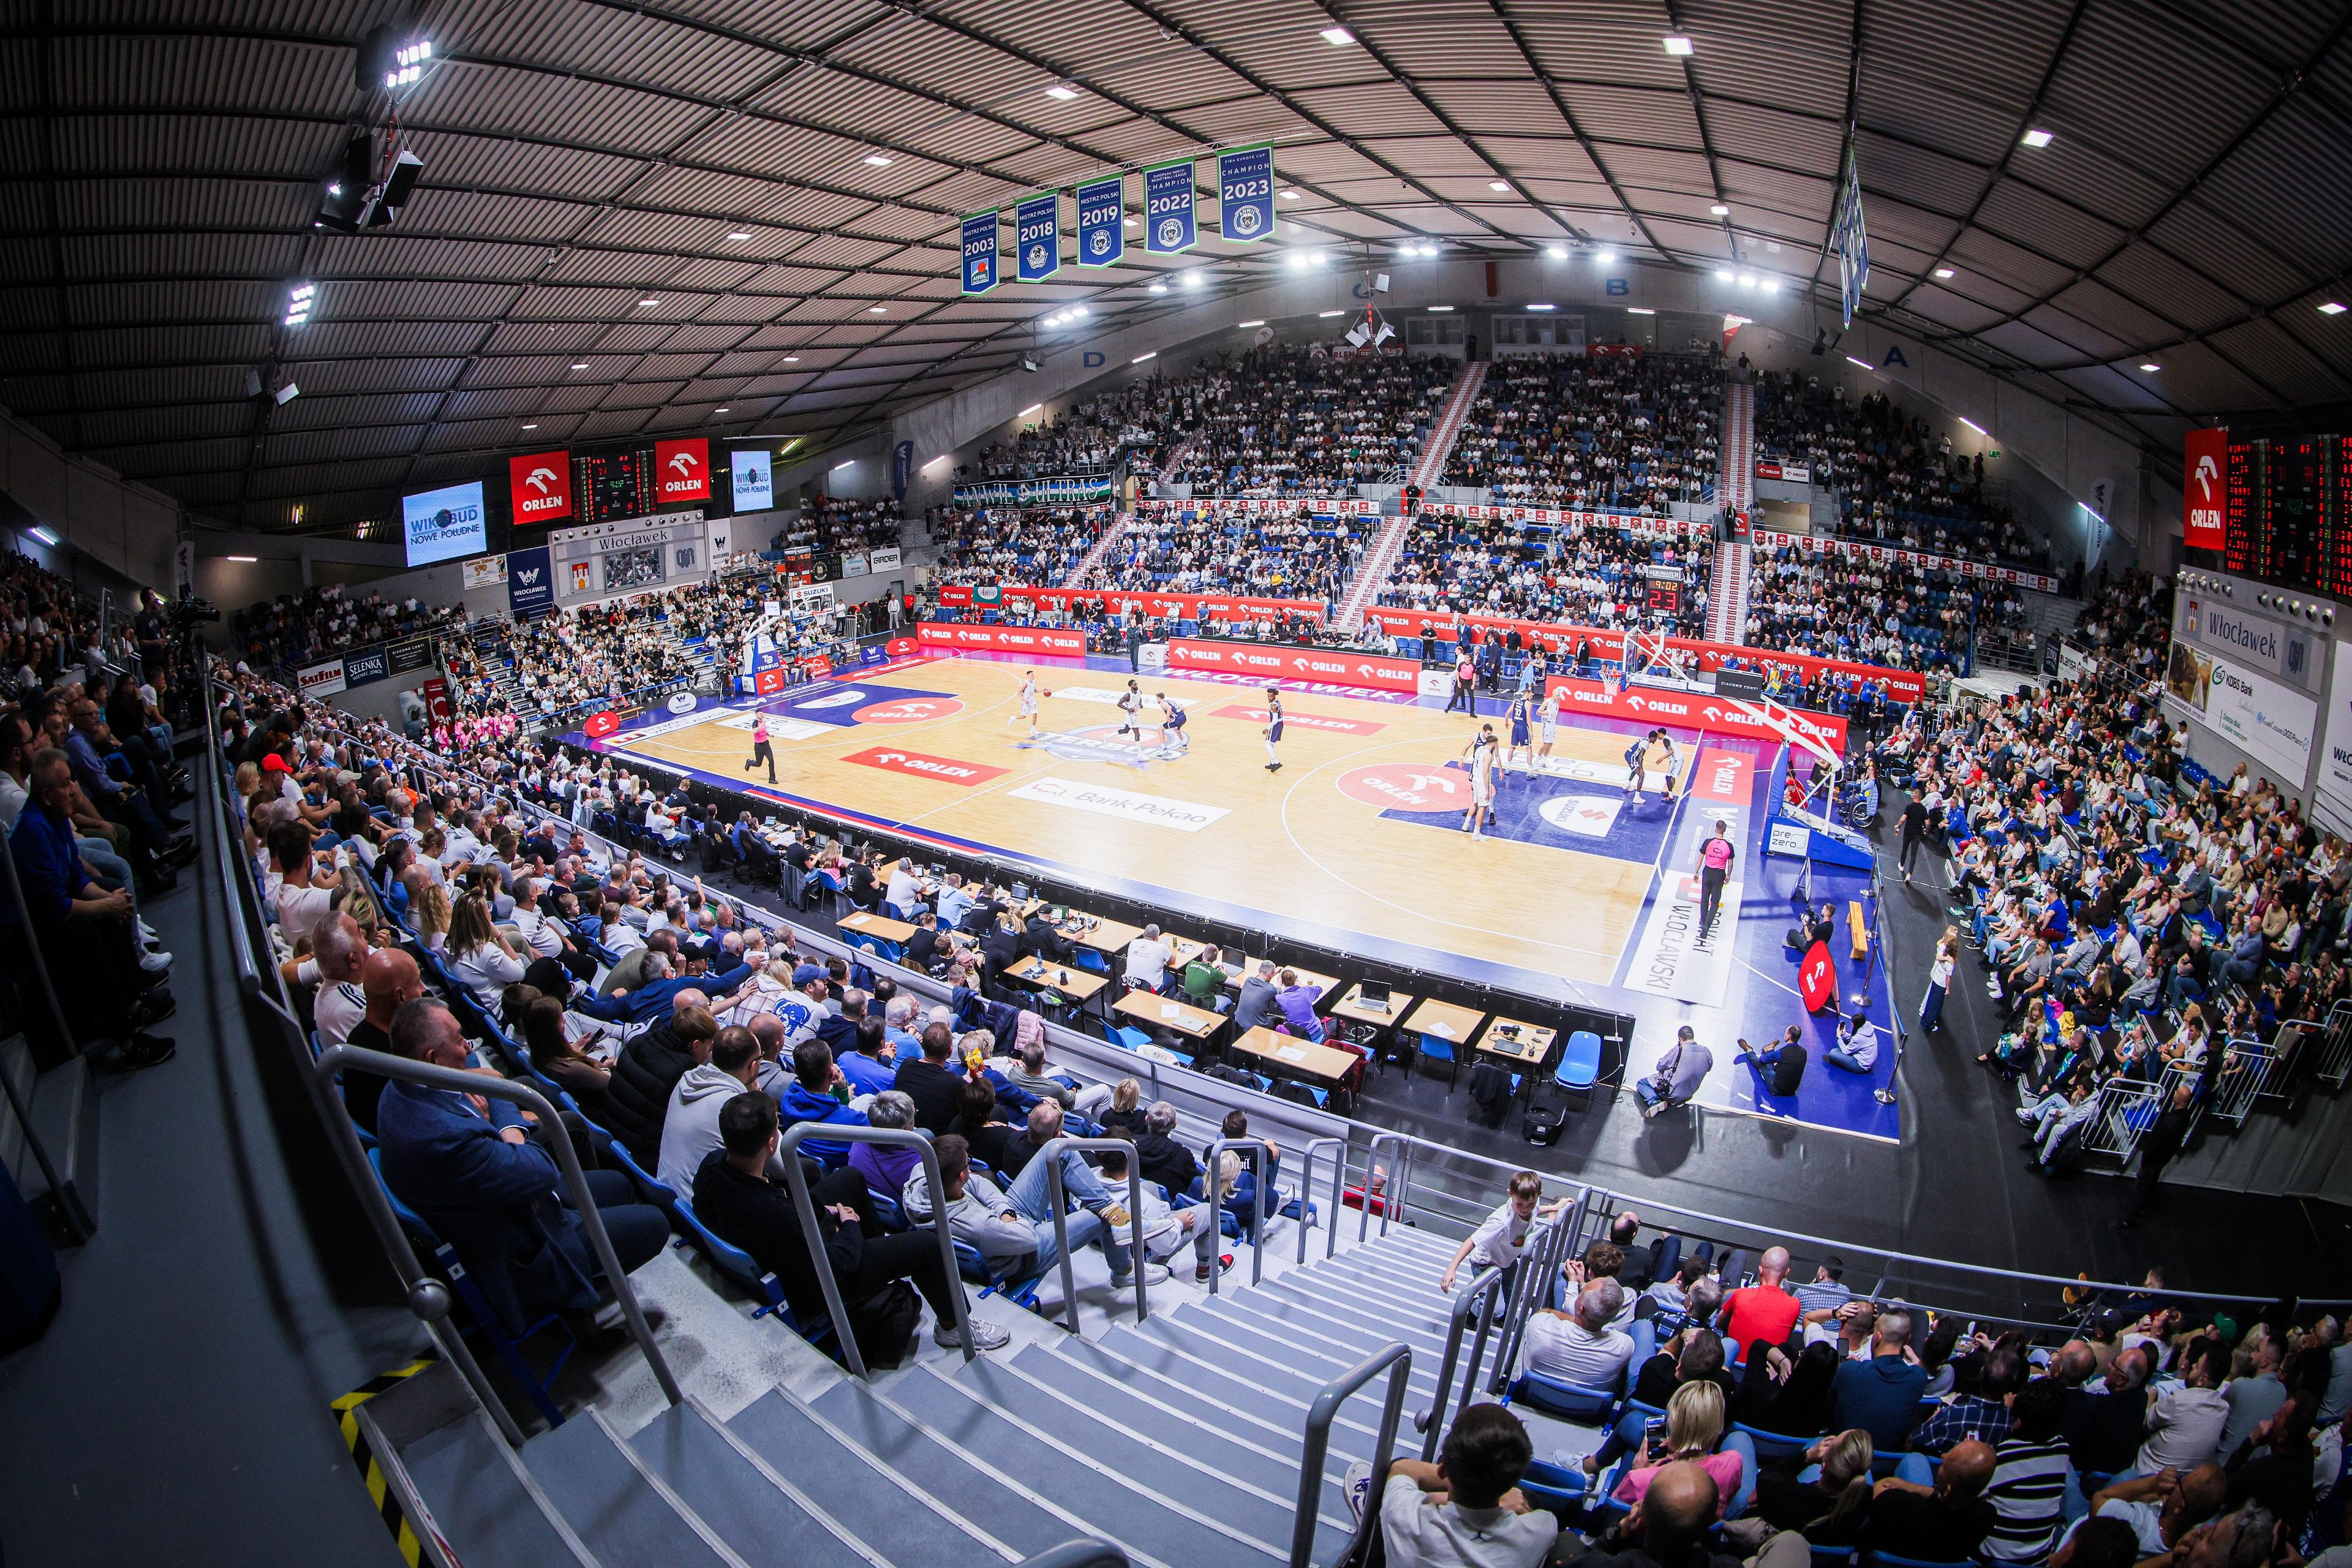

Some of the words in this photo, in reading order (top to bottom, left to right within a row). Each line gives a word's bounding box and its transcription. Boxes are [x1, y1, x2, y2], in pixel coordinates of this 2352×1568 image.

[1222, 162, 1270, 176] CHAMPION
[1148, 177, 1192, 191] CHAMPION
[1225, 179, 1269, 200] 2023
[1081, 194, 1099, 205] MISTRZ
[1100, 191, 1119, 200] POLSKI
[1150, 194, 1190, 214] 2022
[1019, 211, 1036, 221] MISTRZ
[1037, 207, 1054, 216] POLSKI
[1082, 206, 1118, 227] 2019
[1239, 208, 1256, 216] ANWIL
[963, 228, 979, 238] MISTRZ
[979, 224, 995, 233] POLSKI
[1020, 221, 1054, 242] 2018
[1163, 221, 1180, 230] ANWIL
[1092, 230, 1109, 240] ANWIL
[965, 237, 994, 257] 2003
[1606, 279, 1629, 296] B
[1084, 352, 1105, 368] D
[1883, 346, 1909, 368] A
[665, 479, 701, 492] ORLEN
[736, 486, 750, 494] NOWE
[1035, 478, 1098, 503] ULTRAS
[963, 484, 1014, 507] ANWIL
[522, 495, 563, 513] ORLEN
[2191, 508, 2221, 529] ORLEN
[410, 532, 438, 546] NOWE
[441, 524, 480, 540] POŁUDNIE
[599, 530, 668, 550] Włocławek
[873, 554, 899, 564] GIRDER
[513, 586, 547, 597] WŁOCŁAWEK
[803, 587, 828, 597] SUZUKI
[1656, 581, 1678, 591] 9:02
[1649, 590, 1676, 610] 23
[1383, 617, 1409, 626] ORLEN
[932, 630, 951, 639] ORLEN
[969, 633, 990, 641] ORLEN
[1011, 635, 1033, 644] ORLEN
[2209, 612, 2277, 660] Włocławek
[1054, 638, 1079, 647] ORLEN
[1605, 639, 1624, 649] ORL
[1190, 650, 1221, 661] ORLEN
[1248, 655, 1281, 667] ORLEN
[349, 658, 382, 677] SELENKA
[757, 663, 779, 671] TERBUD
[1311, 661, 1346, 674] ORLEN
[1376, 668, 1412, 681] ORLEN
[1834, 671, 1862, 682] OLEN
[1159, 668, 1405, 701] WŁOCŁAWEK
[1893, 680, 1920, 692] ORLEN
[2226, 674, 2241, 691] KDBS
[2240, 681, 2253, 697] Bank
[1574, 690, 1613, 704] ORLEN
[1648, 701, 1687, 715] ORLEN
[1283, 715, 1357, 729] ORLEN
[1725, 712, 1763, 726] ORLEN
[1799, 724, 1838, 738] ORLEN
[1035, 732, 1182, 760] TERBUD
[904, 760, 979, 778] ORLEN
[2333, 770, 2349, 782] Miasto
[1713, 767, 1735, 794] ORLEN
[1362, 777, 1429, 805] ORLEN
[1074, 791, 1129, 810] Bank
[1133, 802, 1208, 824] Pekao
[1555, 799, 1580, 823] SUZUKI
[1773, 829, 1792, 841] pre
[1772, 838, 1796, 848] zero
[1646, 904, 1692, 990] WŁOCŁAWSKI
[1806, 973, 1816, 993] ORLEN
